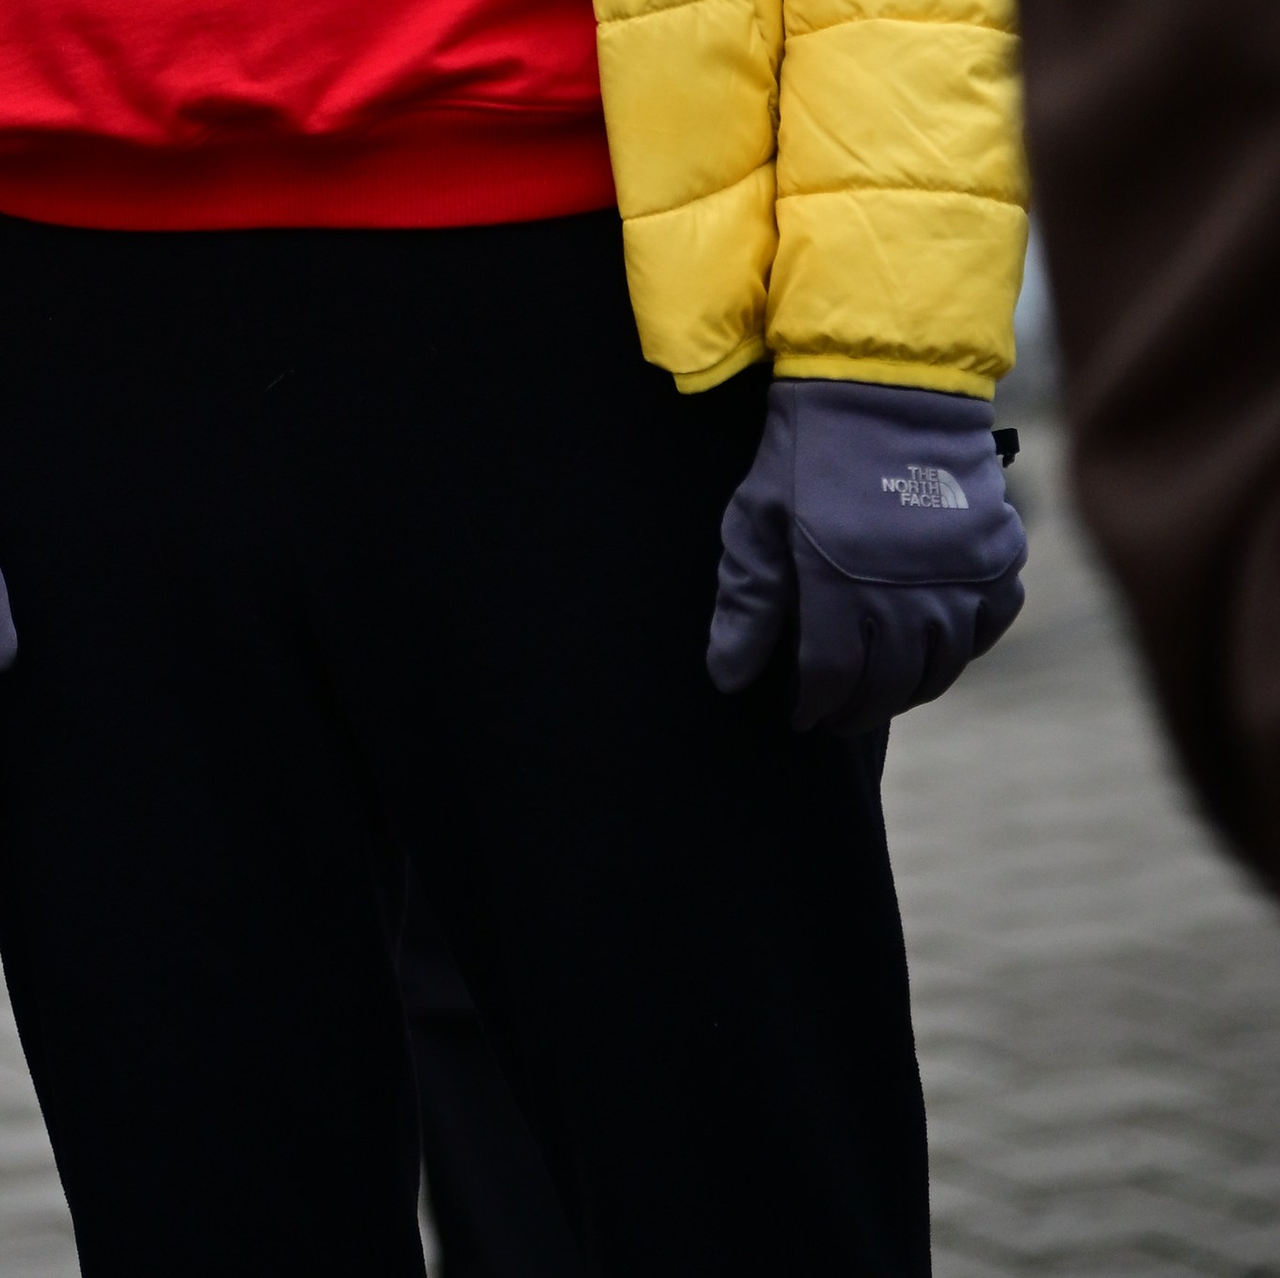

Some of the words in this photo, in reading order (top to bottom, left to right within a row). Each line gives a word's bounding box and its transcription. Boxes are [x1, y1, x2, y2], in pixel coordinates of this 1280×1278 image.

[907, 466, 938, 482] THE
[881, 477, 940, 494] NORTH
[901, 493, 940, 508] FACE
